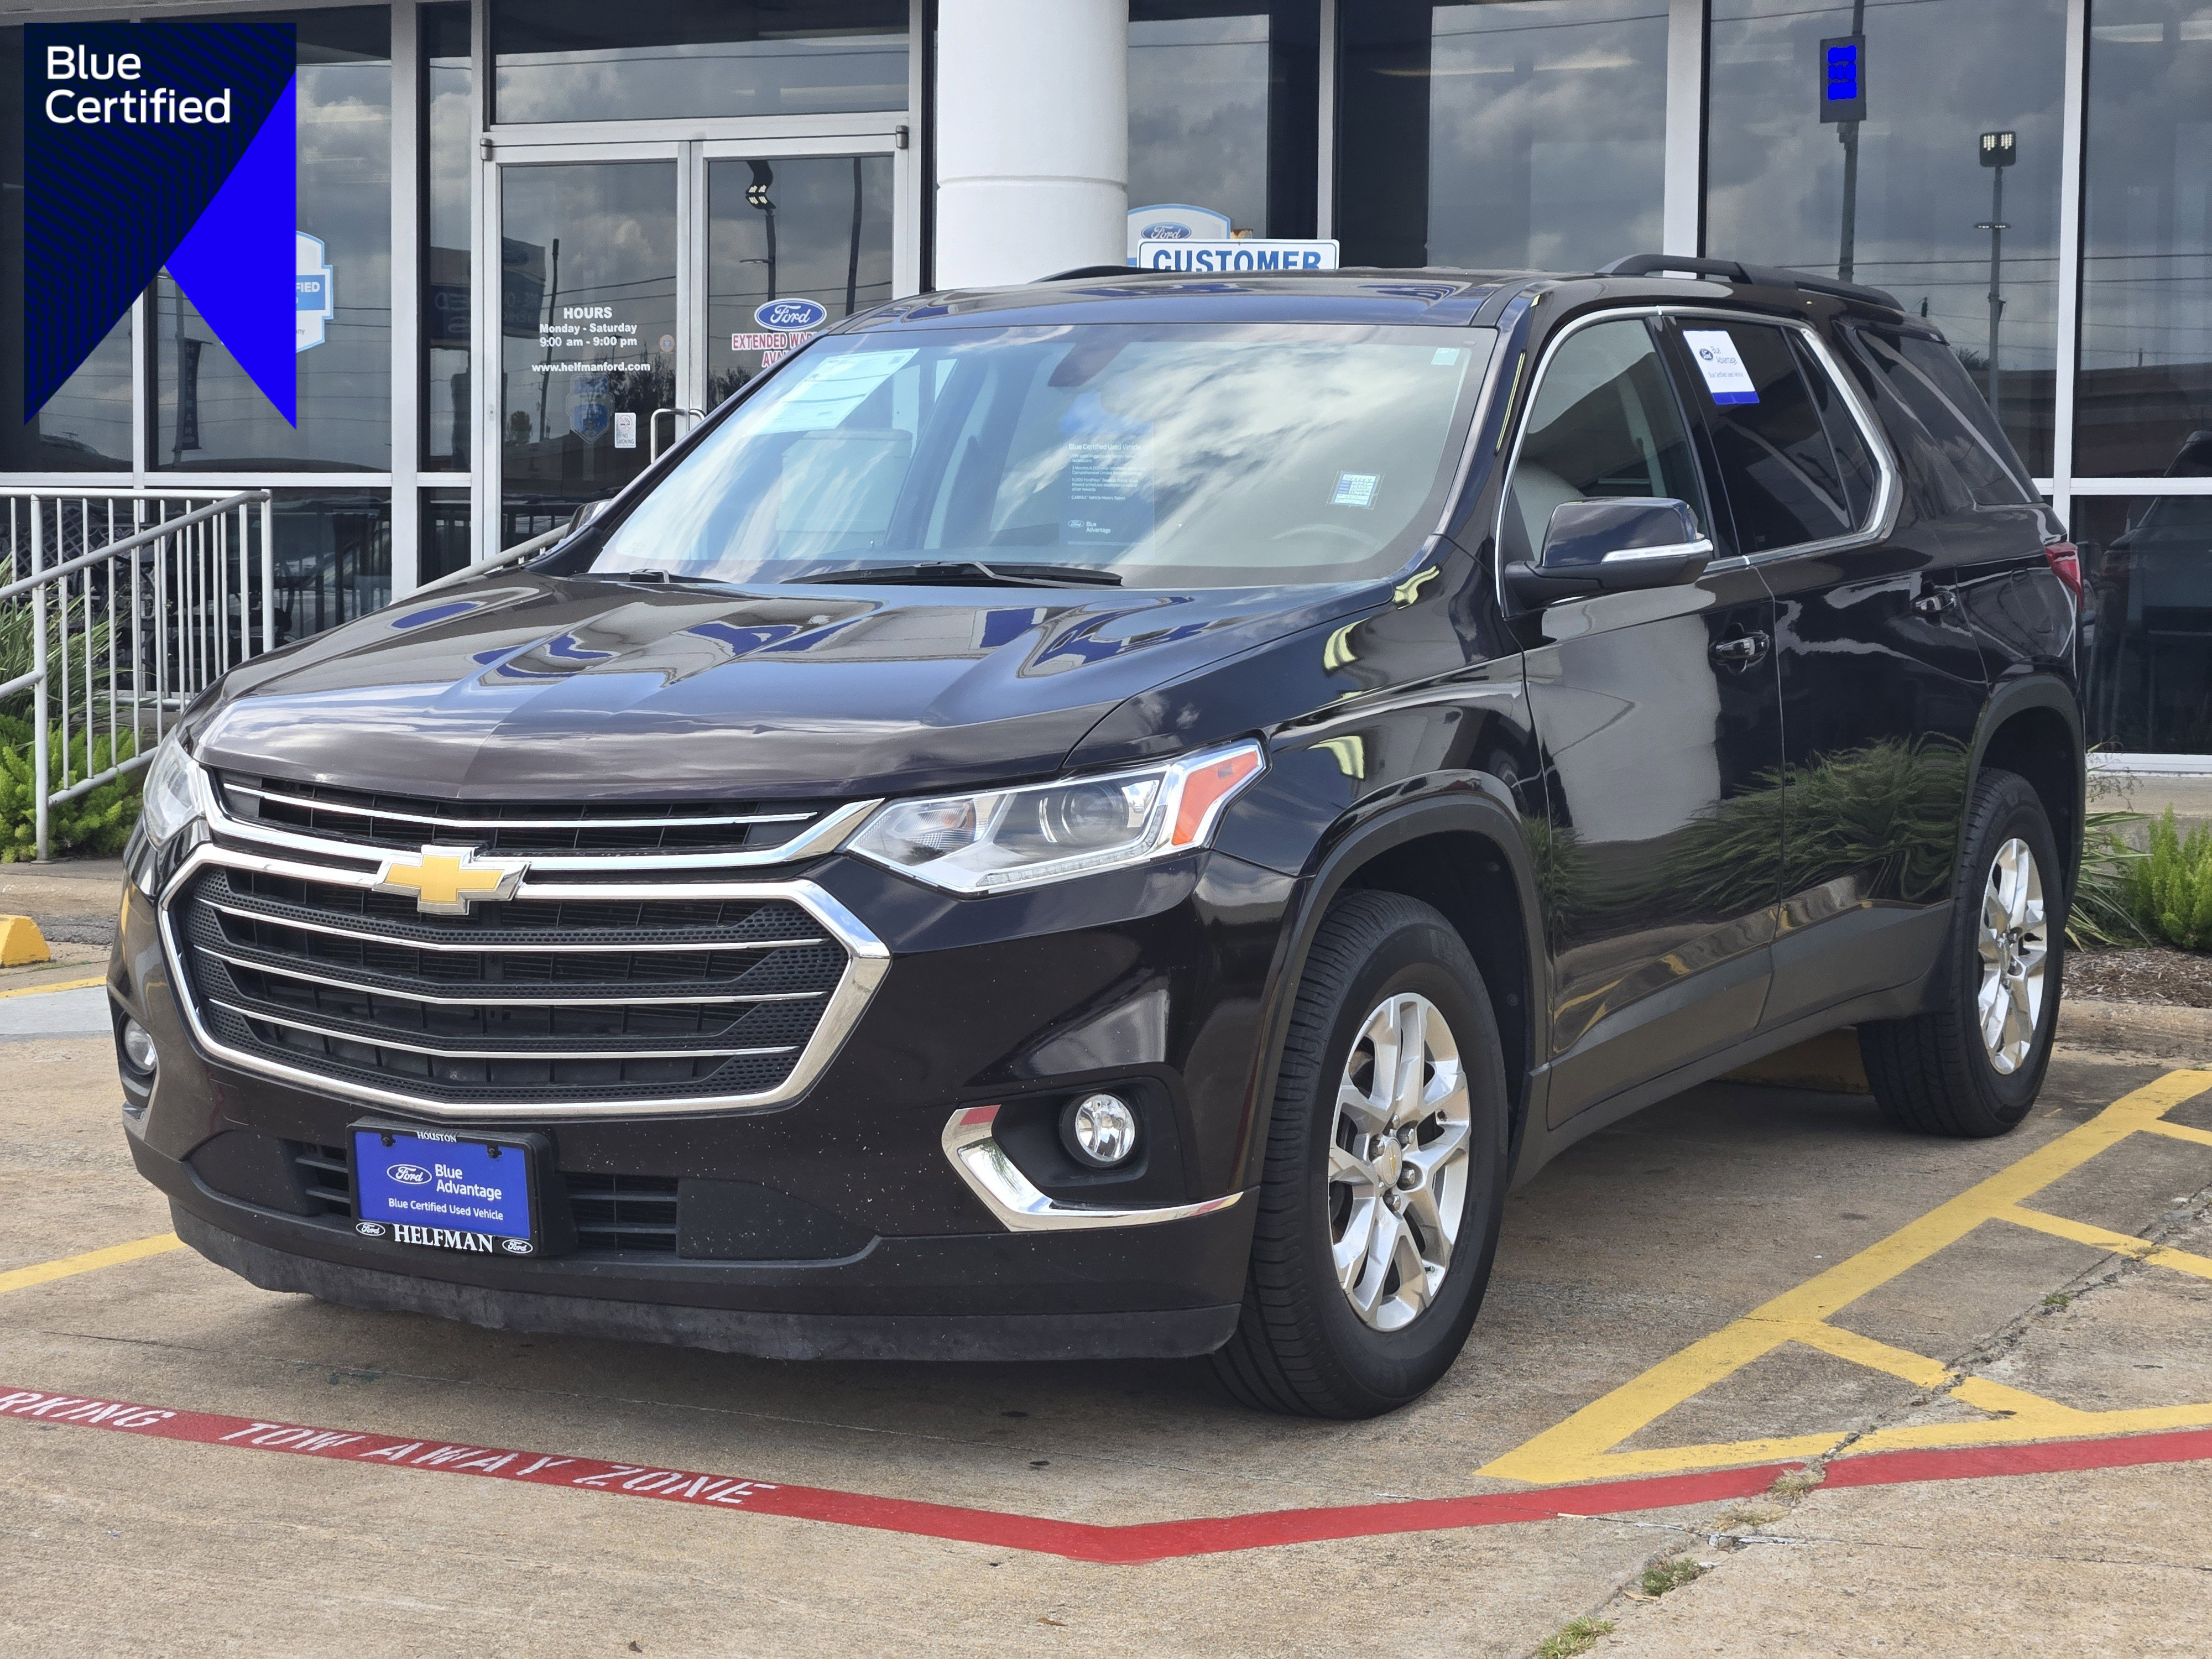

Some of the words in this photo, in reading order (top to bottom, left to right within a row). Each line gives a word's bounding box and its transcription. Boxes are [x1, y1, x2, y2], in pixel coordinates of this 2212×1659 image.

[1151, 226, 1181, 239] Ford
[1153, 249, 1321, 272] CUSTOMER
[563, 307, 613, 319] HOURS
[770, 305, 811, 324] Ford
[539, 324, 580, 335] Monday
[589, 323, 638, 334] Saturday
[540, 337, 562, 347] 9:00
[566, 338, 583, 346] am
[593, 336, 617, 346] 9:00
[620, 338, 638, 348] pm
[733, 333, 786, 349] EXTENDED
[531, 362, 651, 372] www.helfmanford.com
[416, 1131, 457, 1143] HOUSTON
[395, 1166, 424, 1182] Ford
[435, 1164, 463, 1180] Blue
[436, 1179, 502, 1201] Advantage
[388, 1198, 408, 1208] Blue
[410, 1201, 447, 1213] Certified
[449, 1204, 471, 1216] Used
[473, 1207, 504, 1220] Vehicle
[361, 1223, 380, 1234] Ford
[393, 1224, 494, 1253] HELFMAN
[507, 1240, 528, 1251] Ford
[219, 1422, 366, 1451] TOW
[358, 1442, 576, 1475] AWAY
[572, 1464, 779, 1503] ZONE
